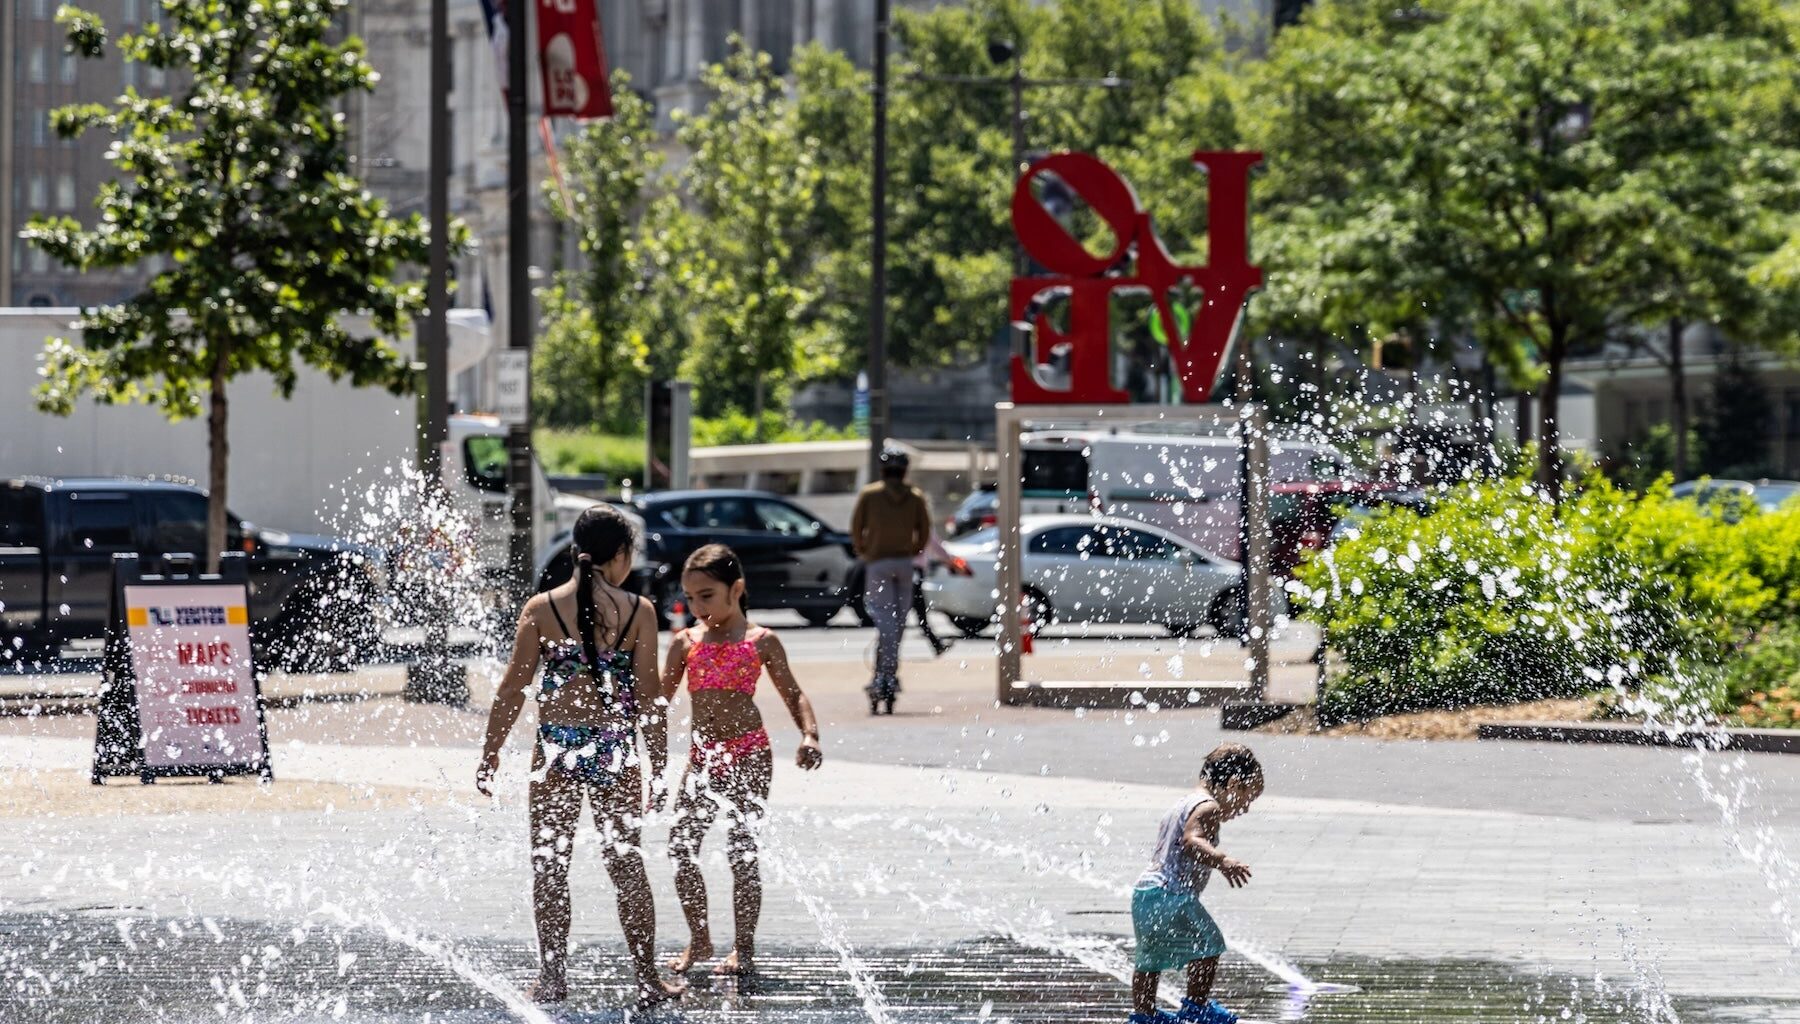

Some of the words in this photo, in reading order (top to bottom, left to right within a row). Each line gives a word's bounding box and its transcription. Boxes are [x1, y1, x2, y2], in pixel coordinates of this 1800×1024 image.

[175, 606, 225, 615] VISITOR
[177, 616, 226, 625] CENTER
[177, 641, 232, 666] MAPS
[186, 705, 241, 724] TICKETS
